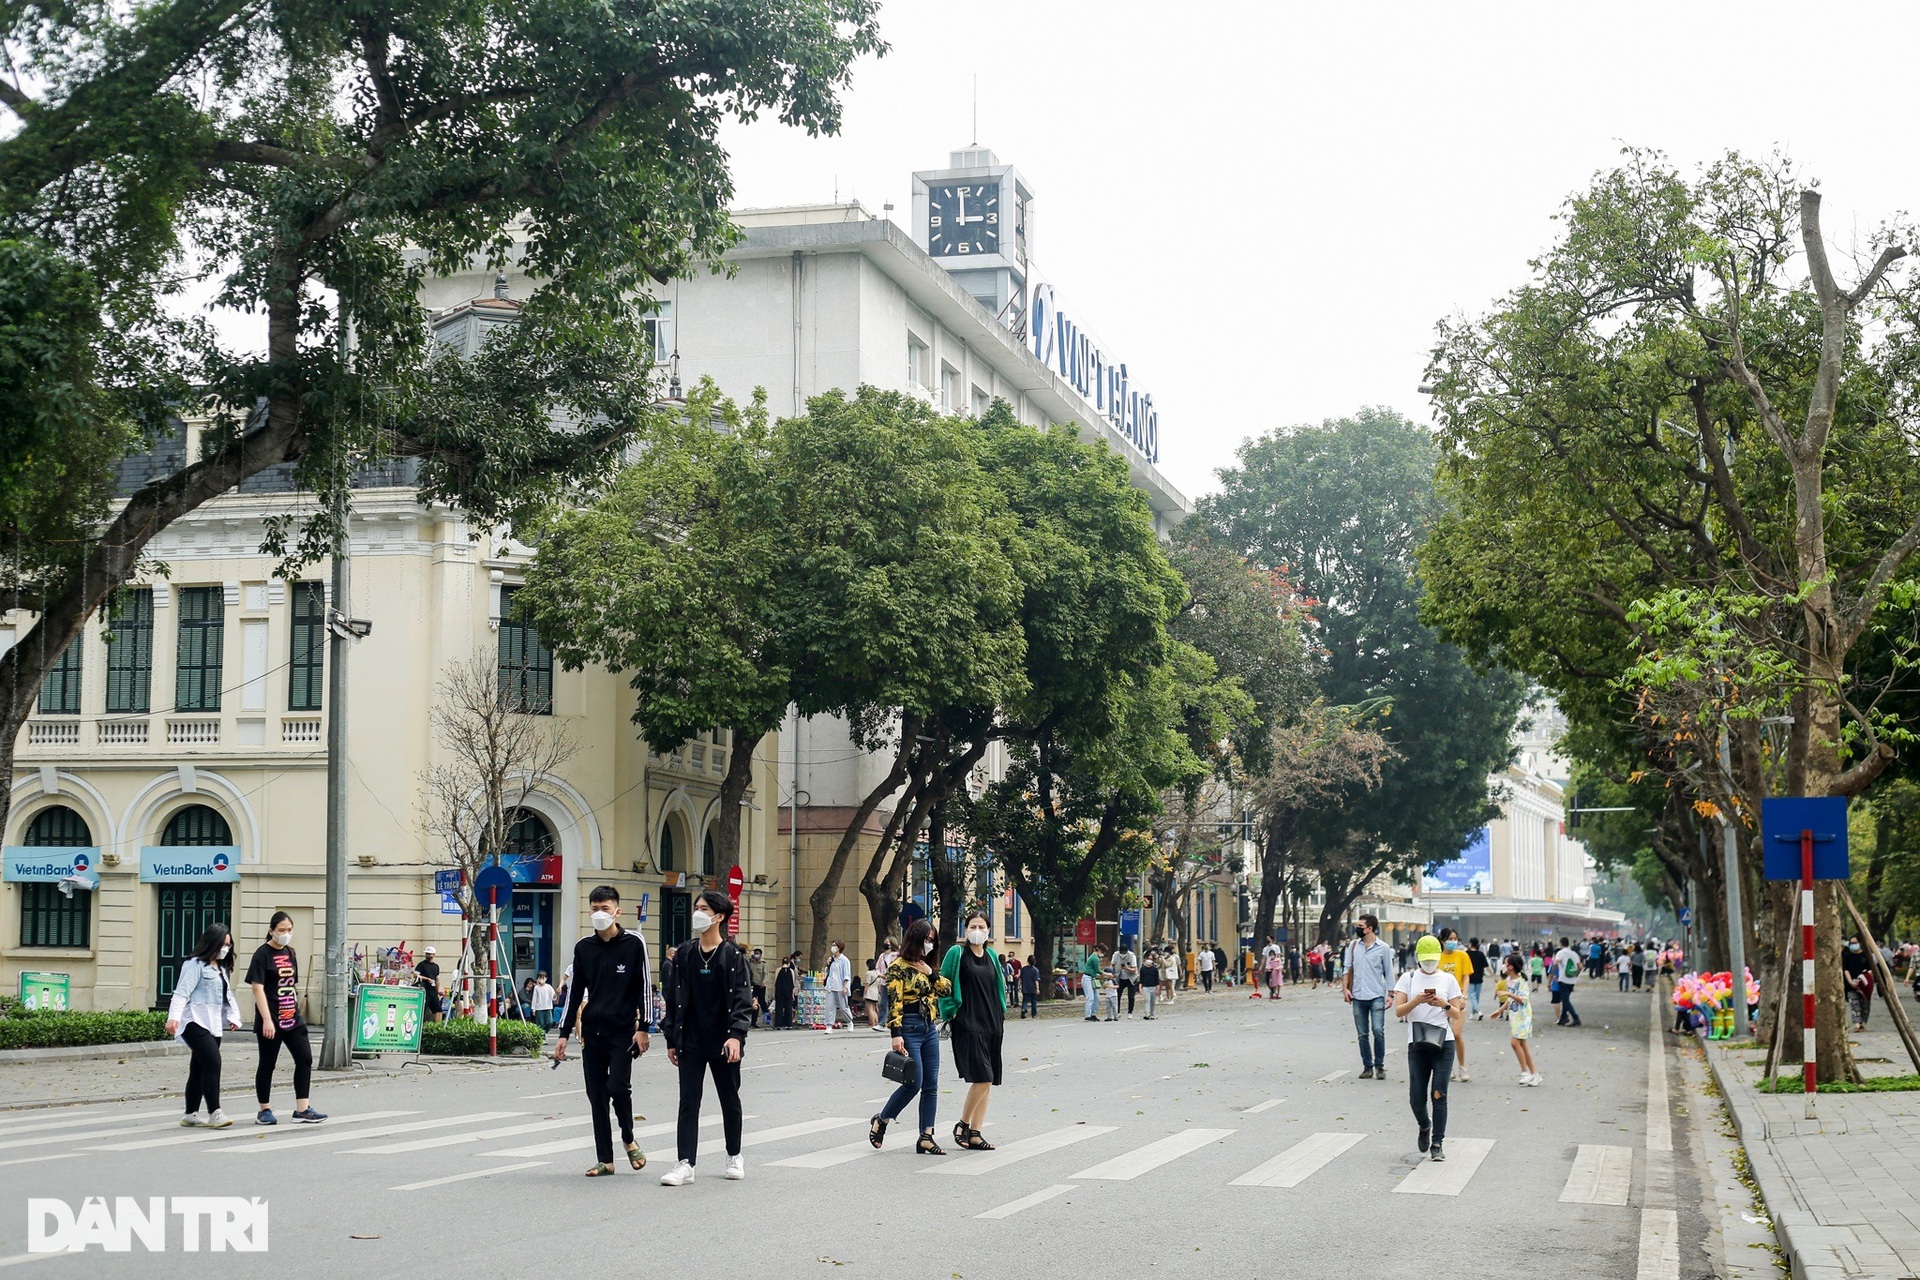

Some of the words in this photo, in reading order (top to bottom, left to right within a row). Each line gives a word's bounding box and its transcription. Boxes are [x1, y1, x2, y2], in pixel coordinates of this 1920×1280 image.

[957, 187, 971, 198] 12
[931, 216, 942, 228] 9
[986, 213, 998, 224] 3
[958, 242, 970, 254] 6
[1057, 311, 1107, 410] VNPT
[1109, 364, 1133, 438] HÀ
[1132, 393, 1159, 465] NỘI
[15, 863, 75, 876] VietinBank
[153, 863, 213, 876] VietinBank
[273, 954, 296, 1029] MOSCHINO
